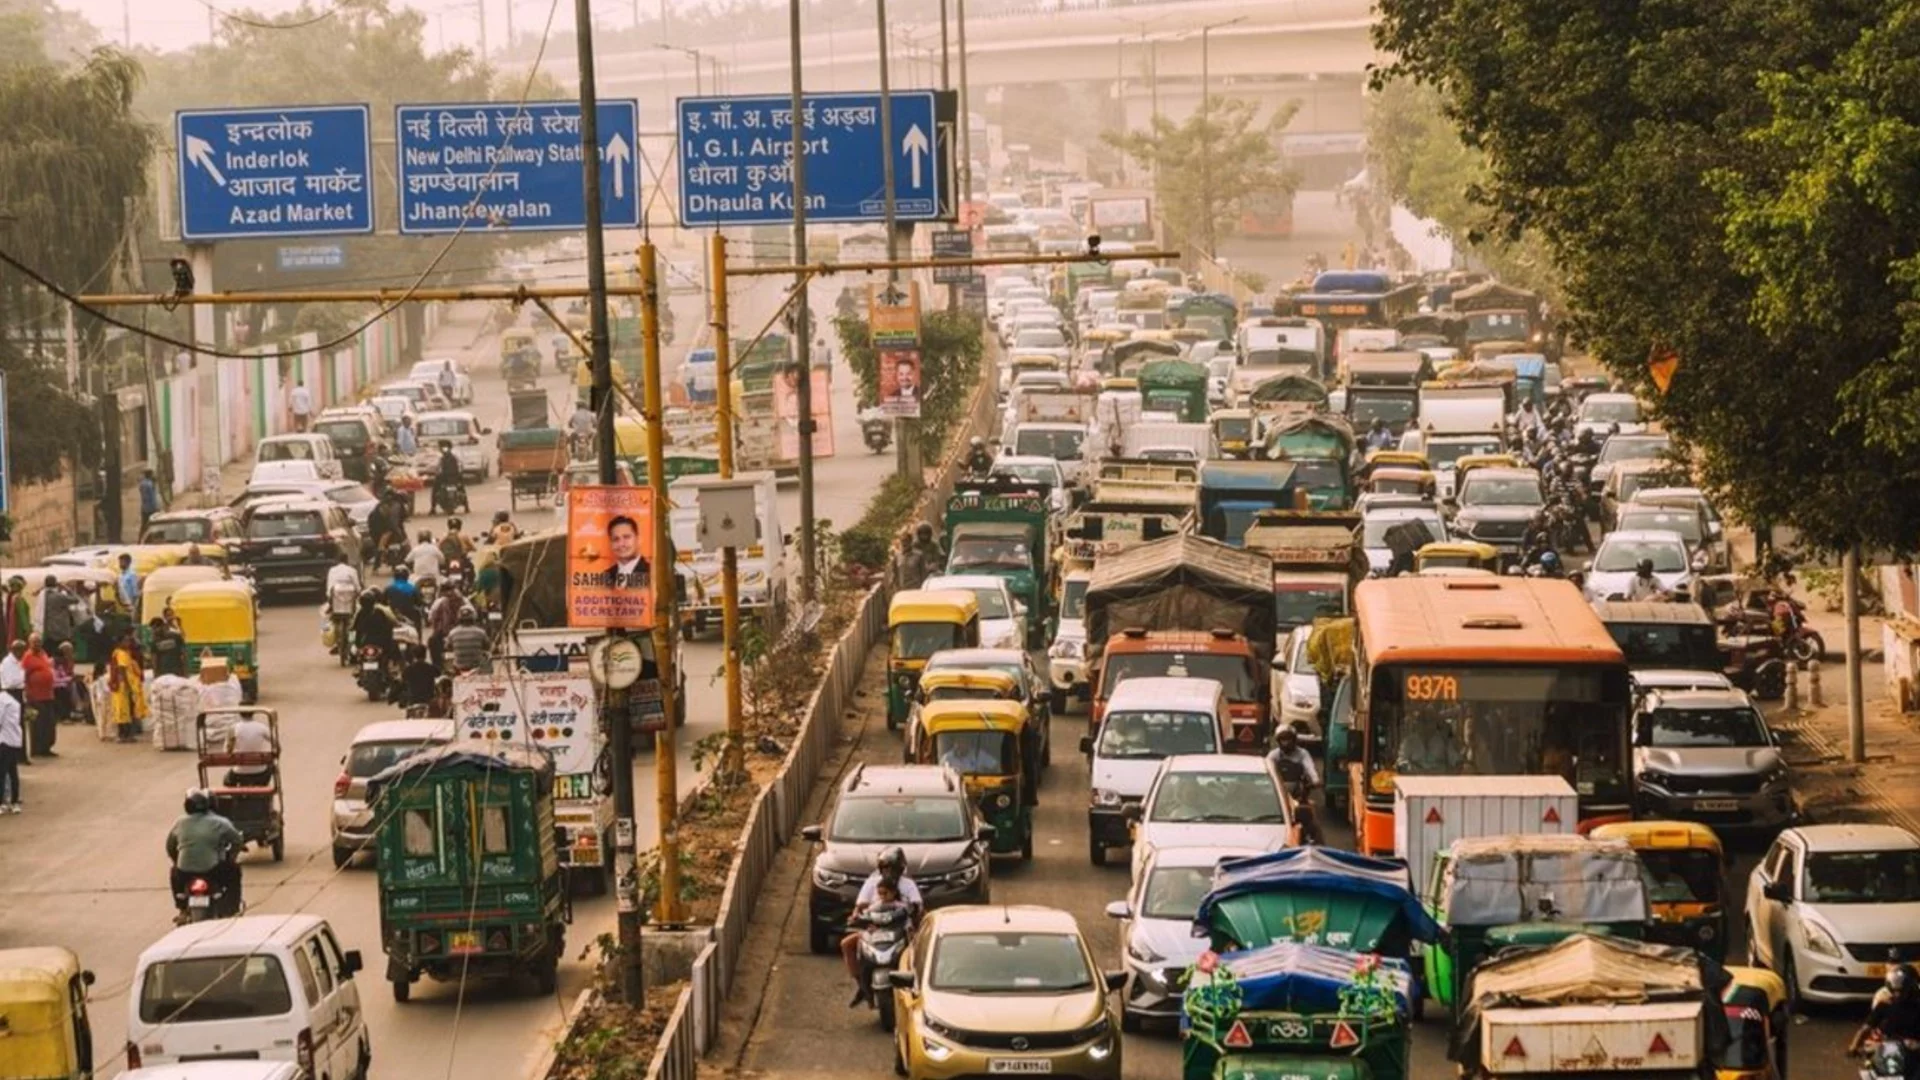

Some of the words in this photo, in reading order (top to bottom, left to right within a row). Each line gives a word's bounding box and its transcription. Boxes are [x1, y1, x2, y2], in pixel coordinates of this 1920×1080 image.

[225, 114, 313, 145] इन्द्रलोक
[406, 112, 430, 141] नई
[438, 111, 488, 138] दिल्ली
[541, 109, 581, 134] स्टेश
[226, 149, 309, 169] Inderlok
[406, 147, 440, 165] New
[444, 146, 482, 164] Delhi
[485, 144, 544, 167] Railway
[228, 176, 297, 196] आजाद
[304, 167, 362, 194] मार्केट
[688, 160, 738, 186] धौला
[230, 204, 281, 224] Azad
[287, 203, 353, 222] Market
[408, 200, 551, 221] Jhandewalan
[690, 193, 763, 212] Dhaula
[574, 595, 647, 605] ADDITIONAL
[574, 606, 645, 617] SECRETARY
[1406, 673, 1458, 701] 937A
